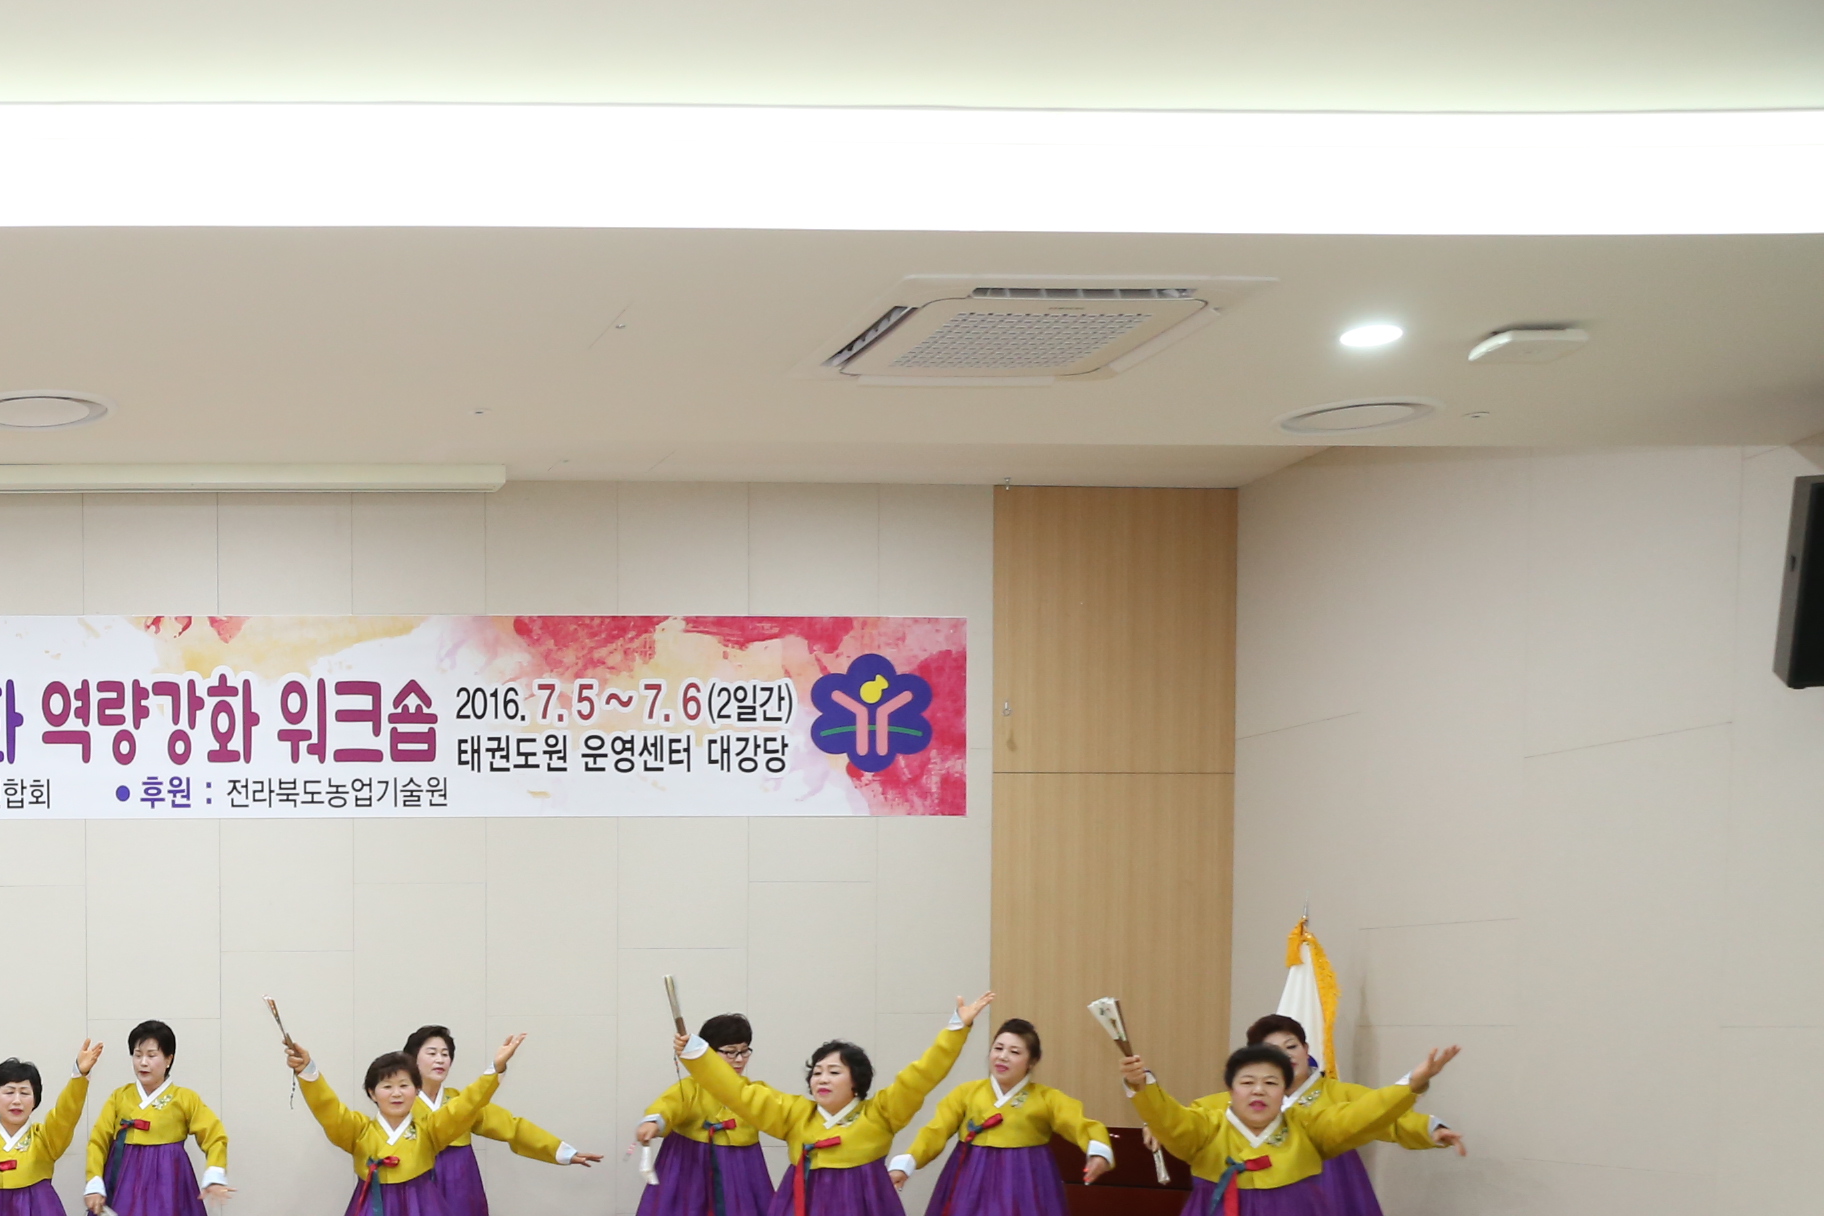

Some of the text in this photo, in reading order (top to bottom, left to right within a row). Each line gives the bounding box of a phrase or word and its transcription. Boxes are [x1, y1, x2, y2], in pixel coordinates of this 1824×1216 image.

[41, 673, 261, 766] 역량강화
[277, 677, 439, 765] 워크숍
[457, 734, 789, 774] 태권도원 운영센터 대강당
[140, 776, 191, 809] 후원
[227, 776, 448, 809] 전라북도농업기술원
